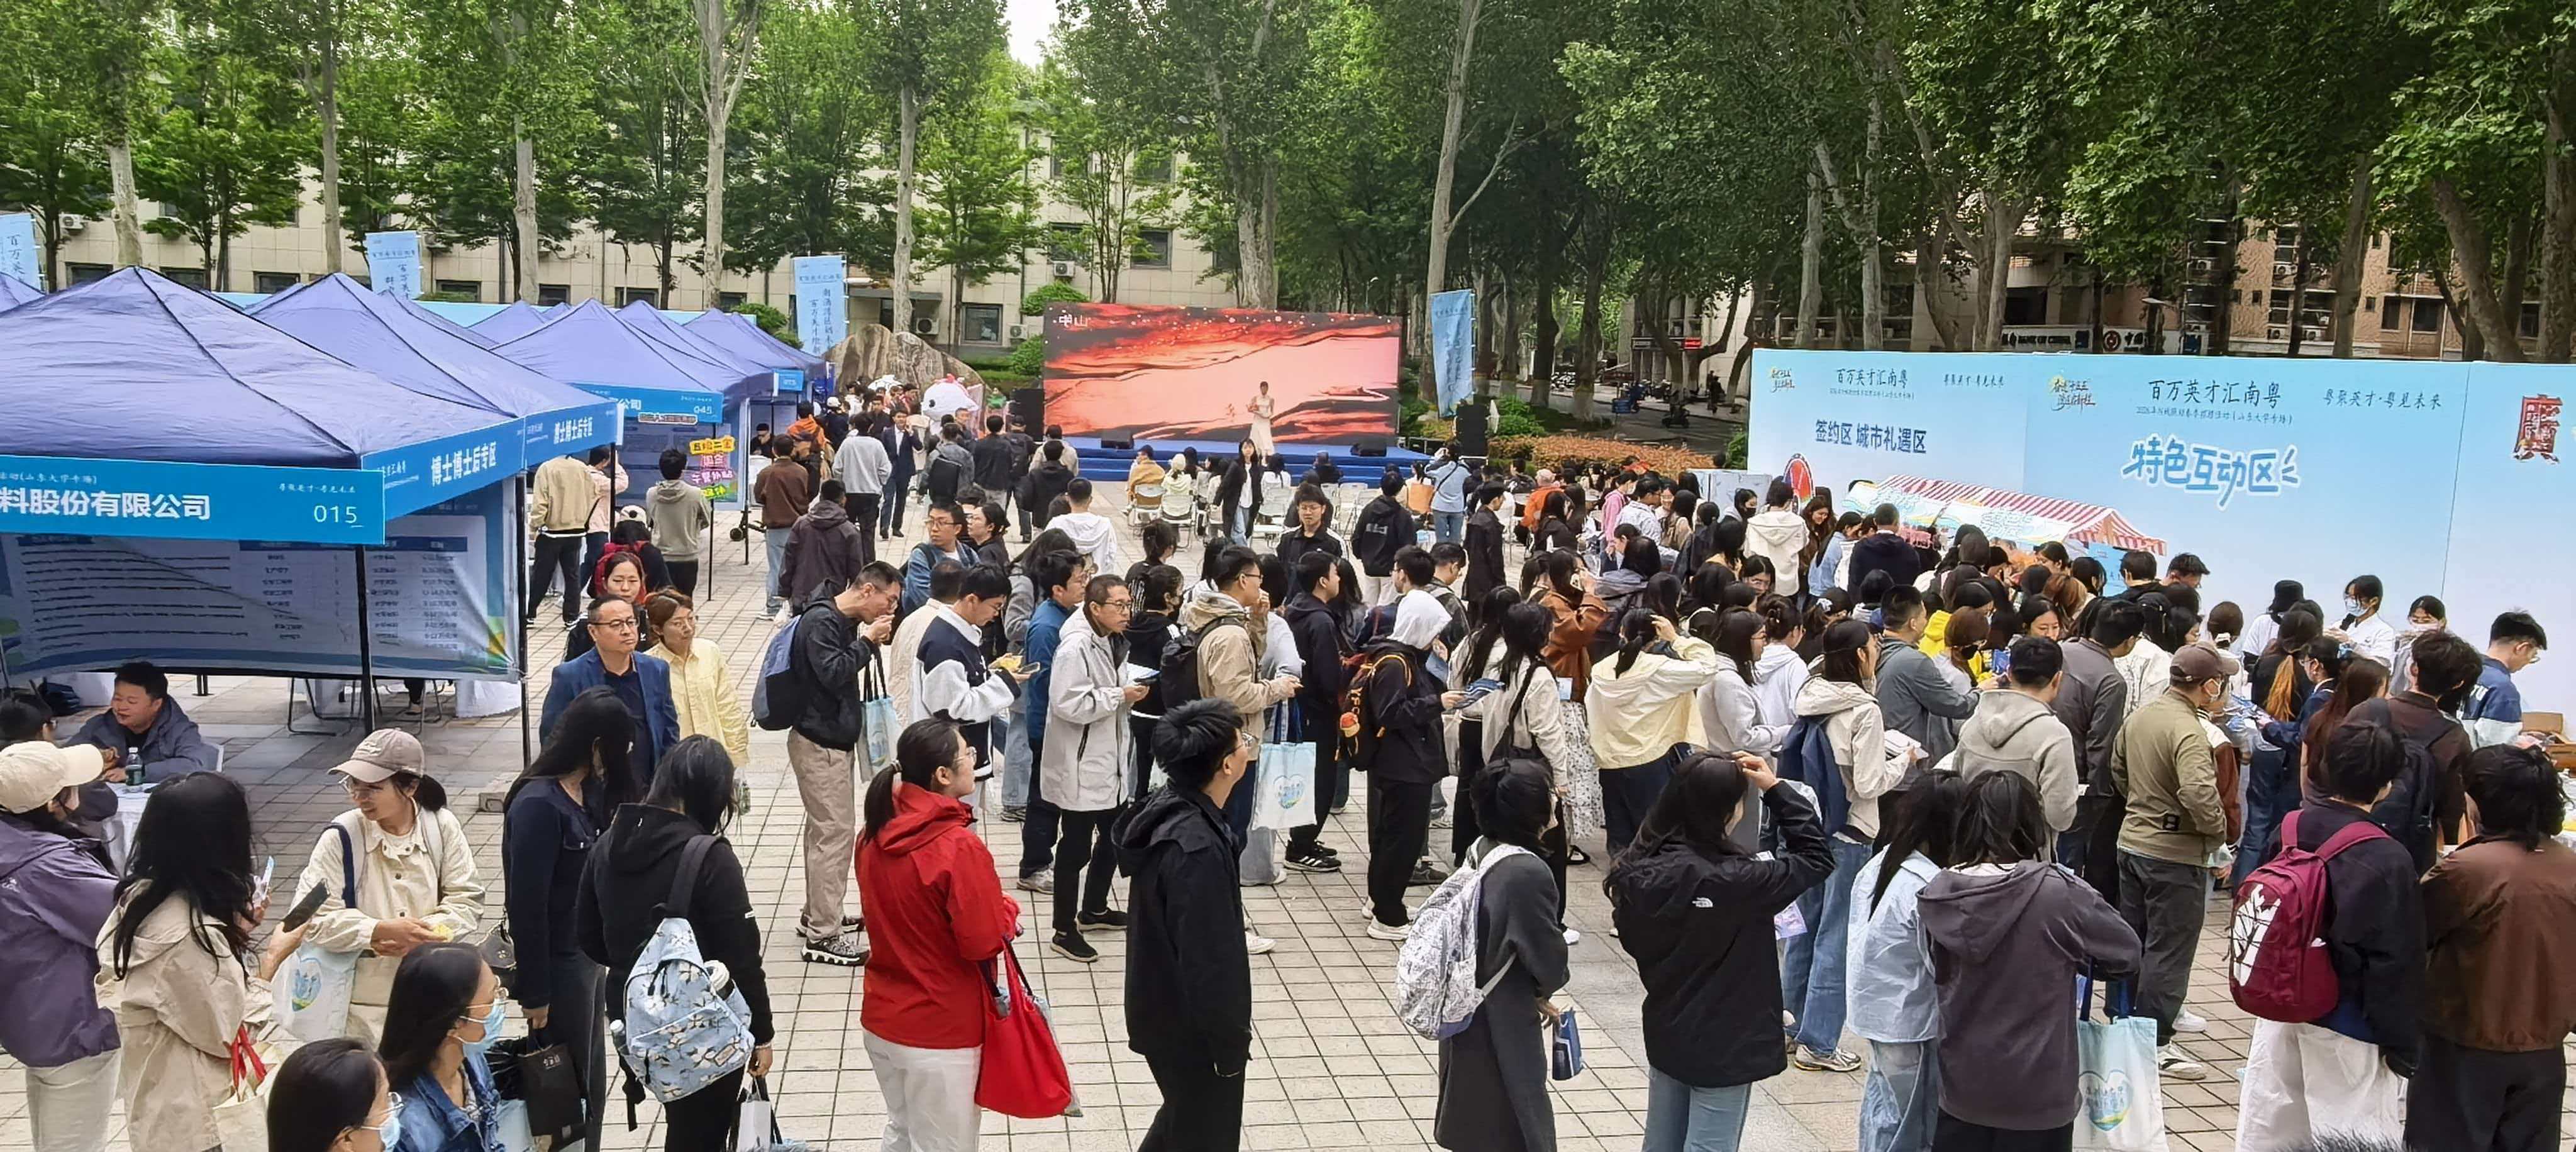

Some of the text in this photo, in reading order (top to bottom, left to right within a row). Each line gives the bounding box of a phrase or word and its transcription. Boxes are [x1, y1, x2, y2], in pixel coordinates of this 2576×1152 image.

[1836, 368, 1908, 388] 百万英才汇南粤
[2148, 379, 2281, 409] 百万英才汇南粤
[609, 397, 641, 410] 公司
[1816, 419, 1926, 454] 签约区 城市礼遇区
[431, 441, 497, 487] 博士博士后专区
[2123, 436, 2279, 507] 特色互动区
[0, 487, 211, 521] 料股份有限公司
[314, 505, 357, 523] 015
